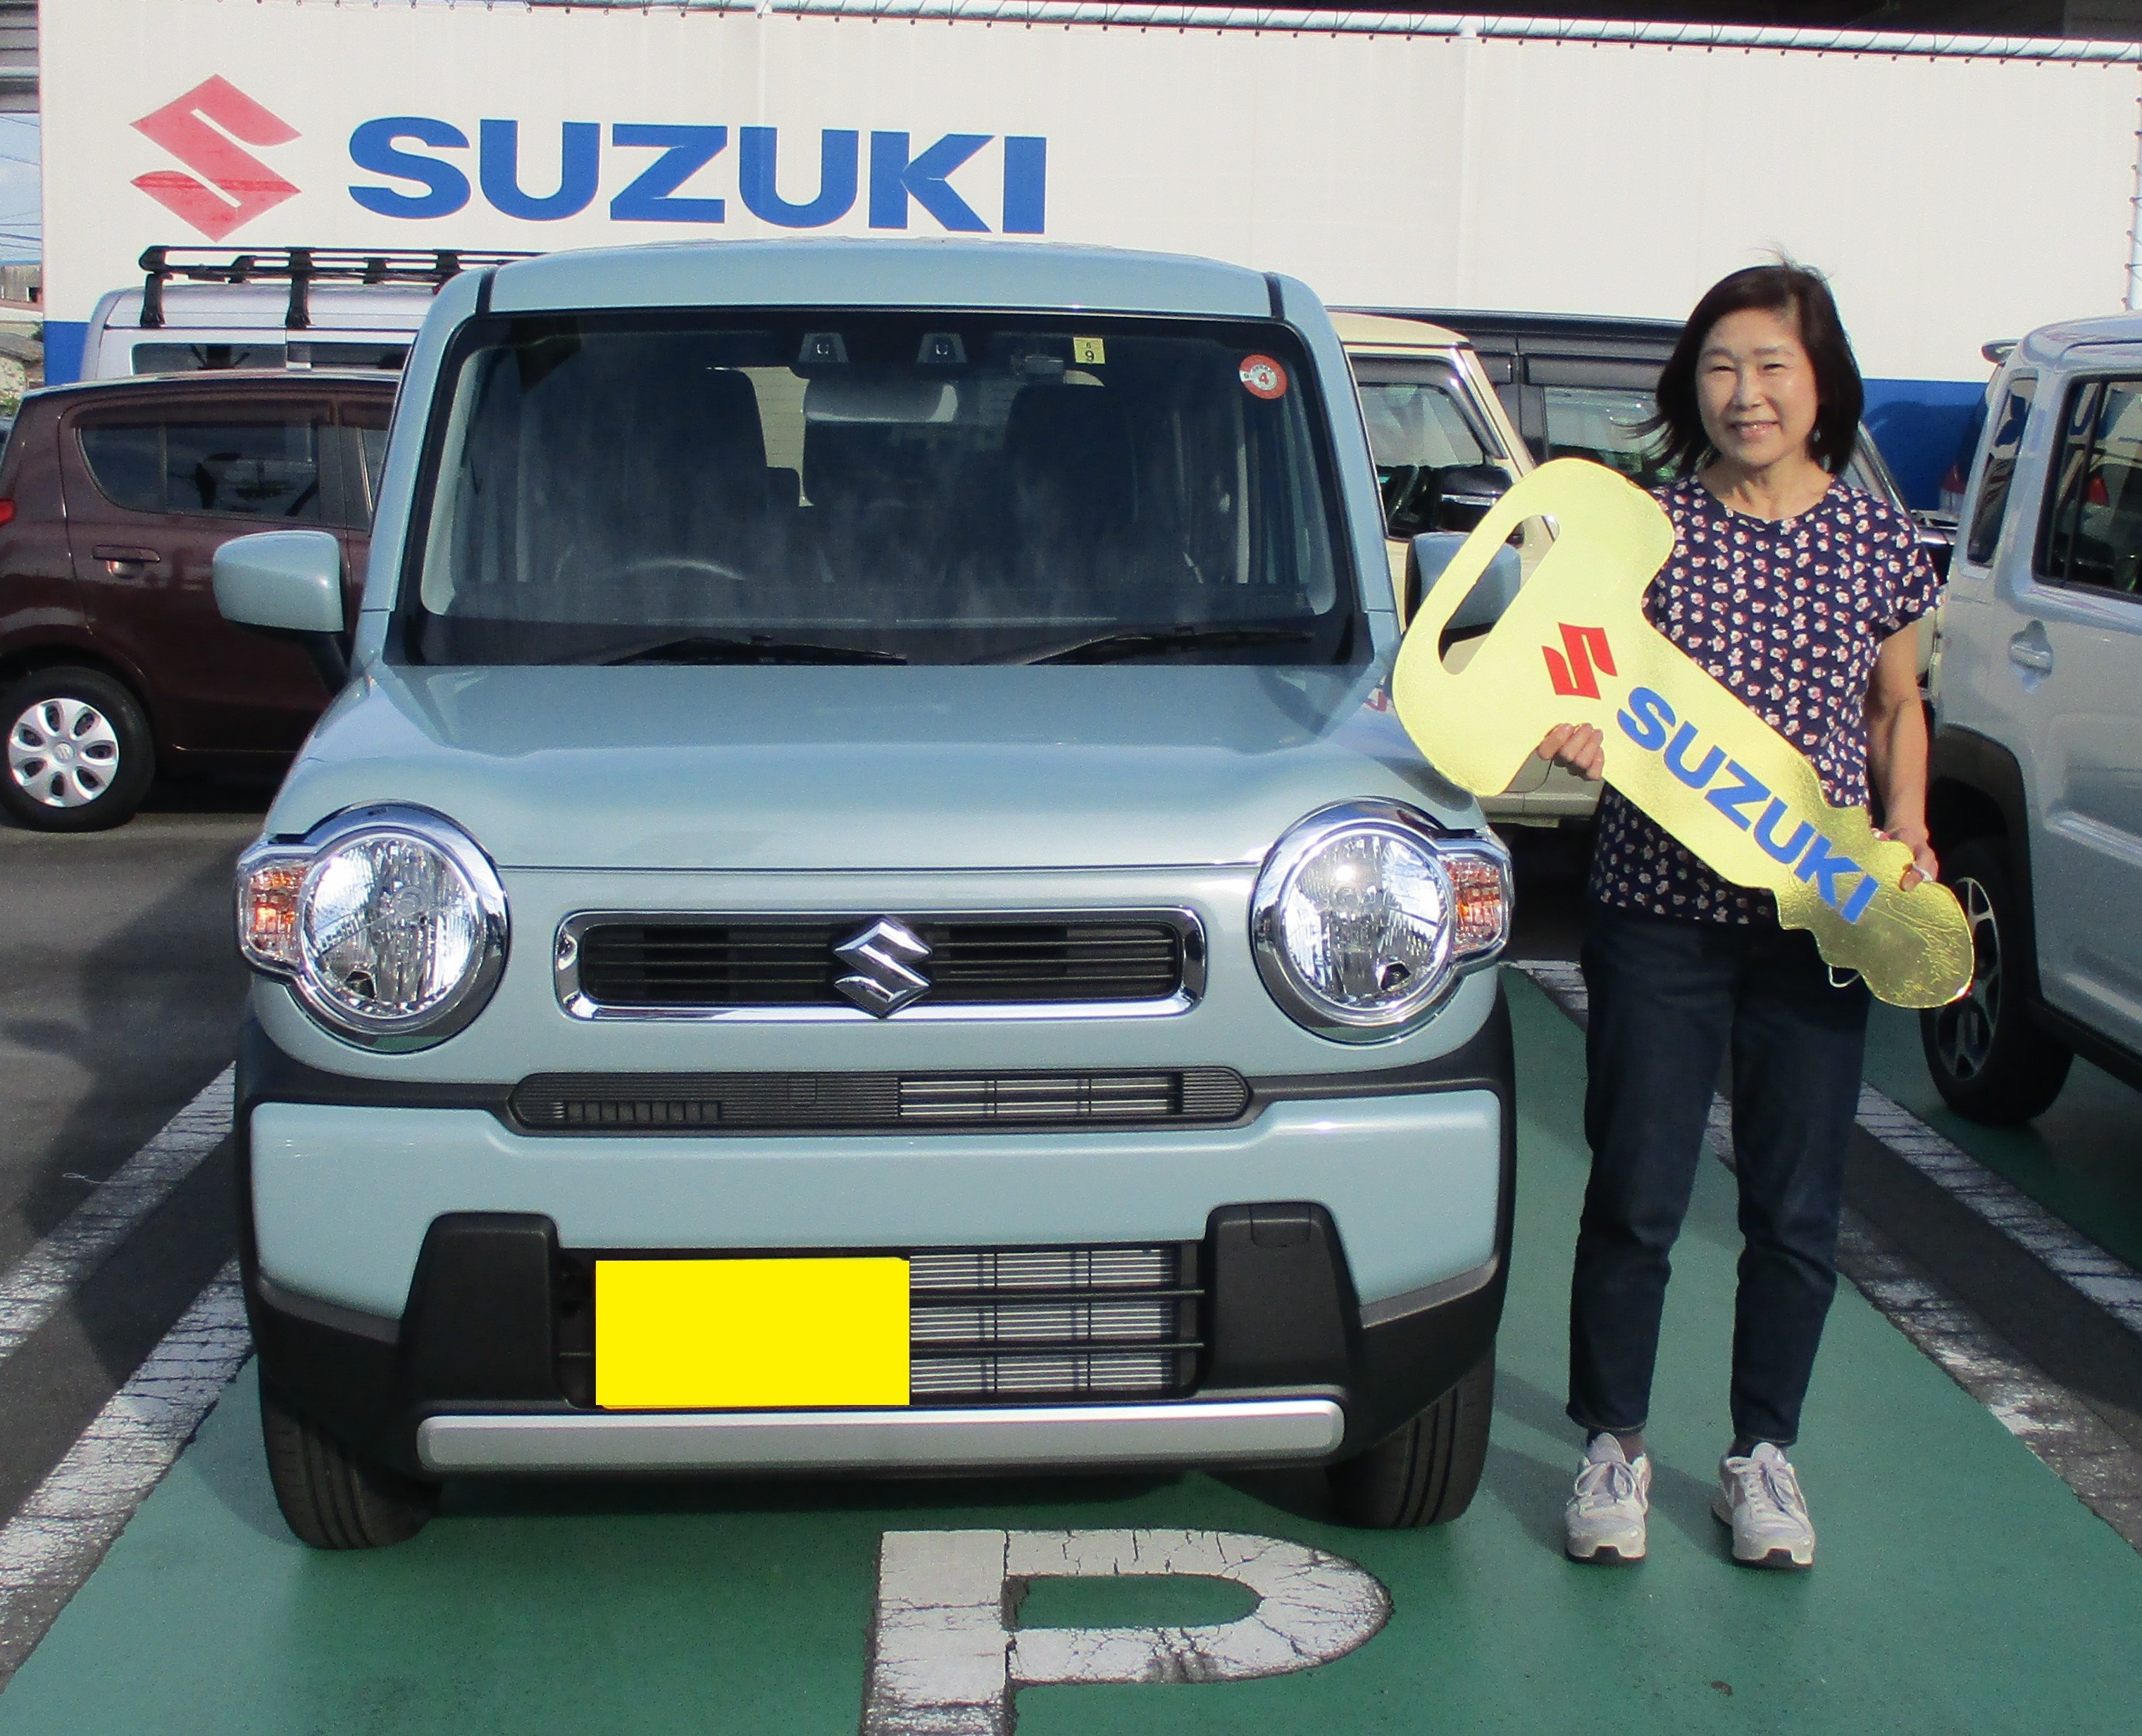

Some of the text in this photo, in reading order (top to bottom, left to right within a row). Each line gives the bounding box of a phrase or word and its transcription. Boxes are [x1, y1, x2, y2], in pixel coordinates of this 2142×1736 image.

[349, 115, 1046, 232] SUZUKI
[1085, 350, 1095, 362] 9
[1258, 372, 1270, 385] 4
[1617, 687, 1880, 923] SUZUKI
[861, 1528, 1395, 1736] P
